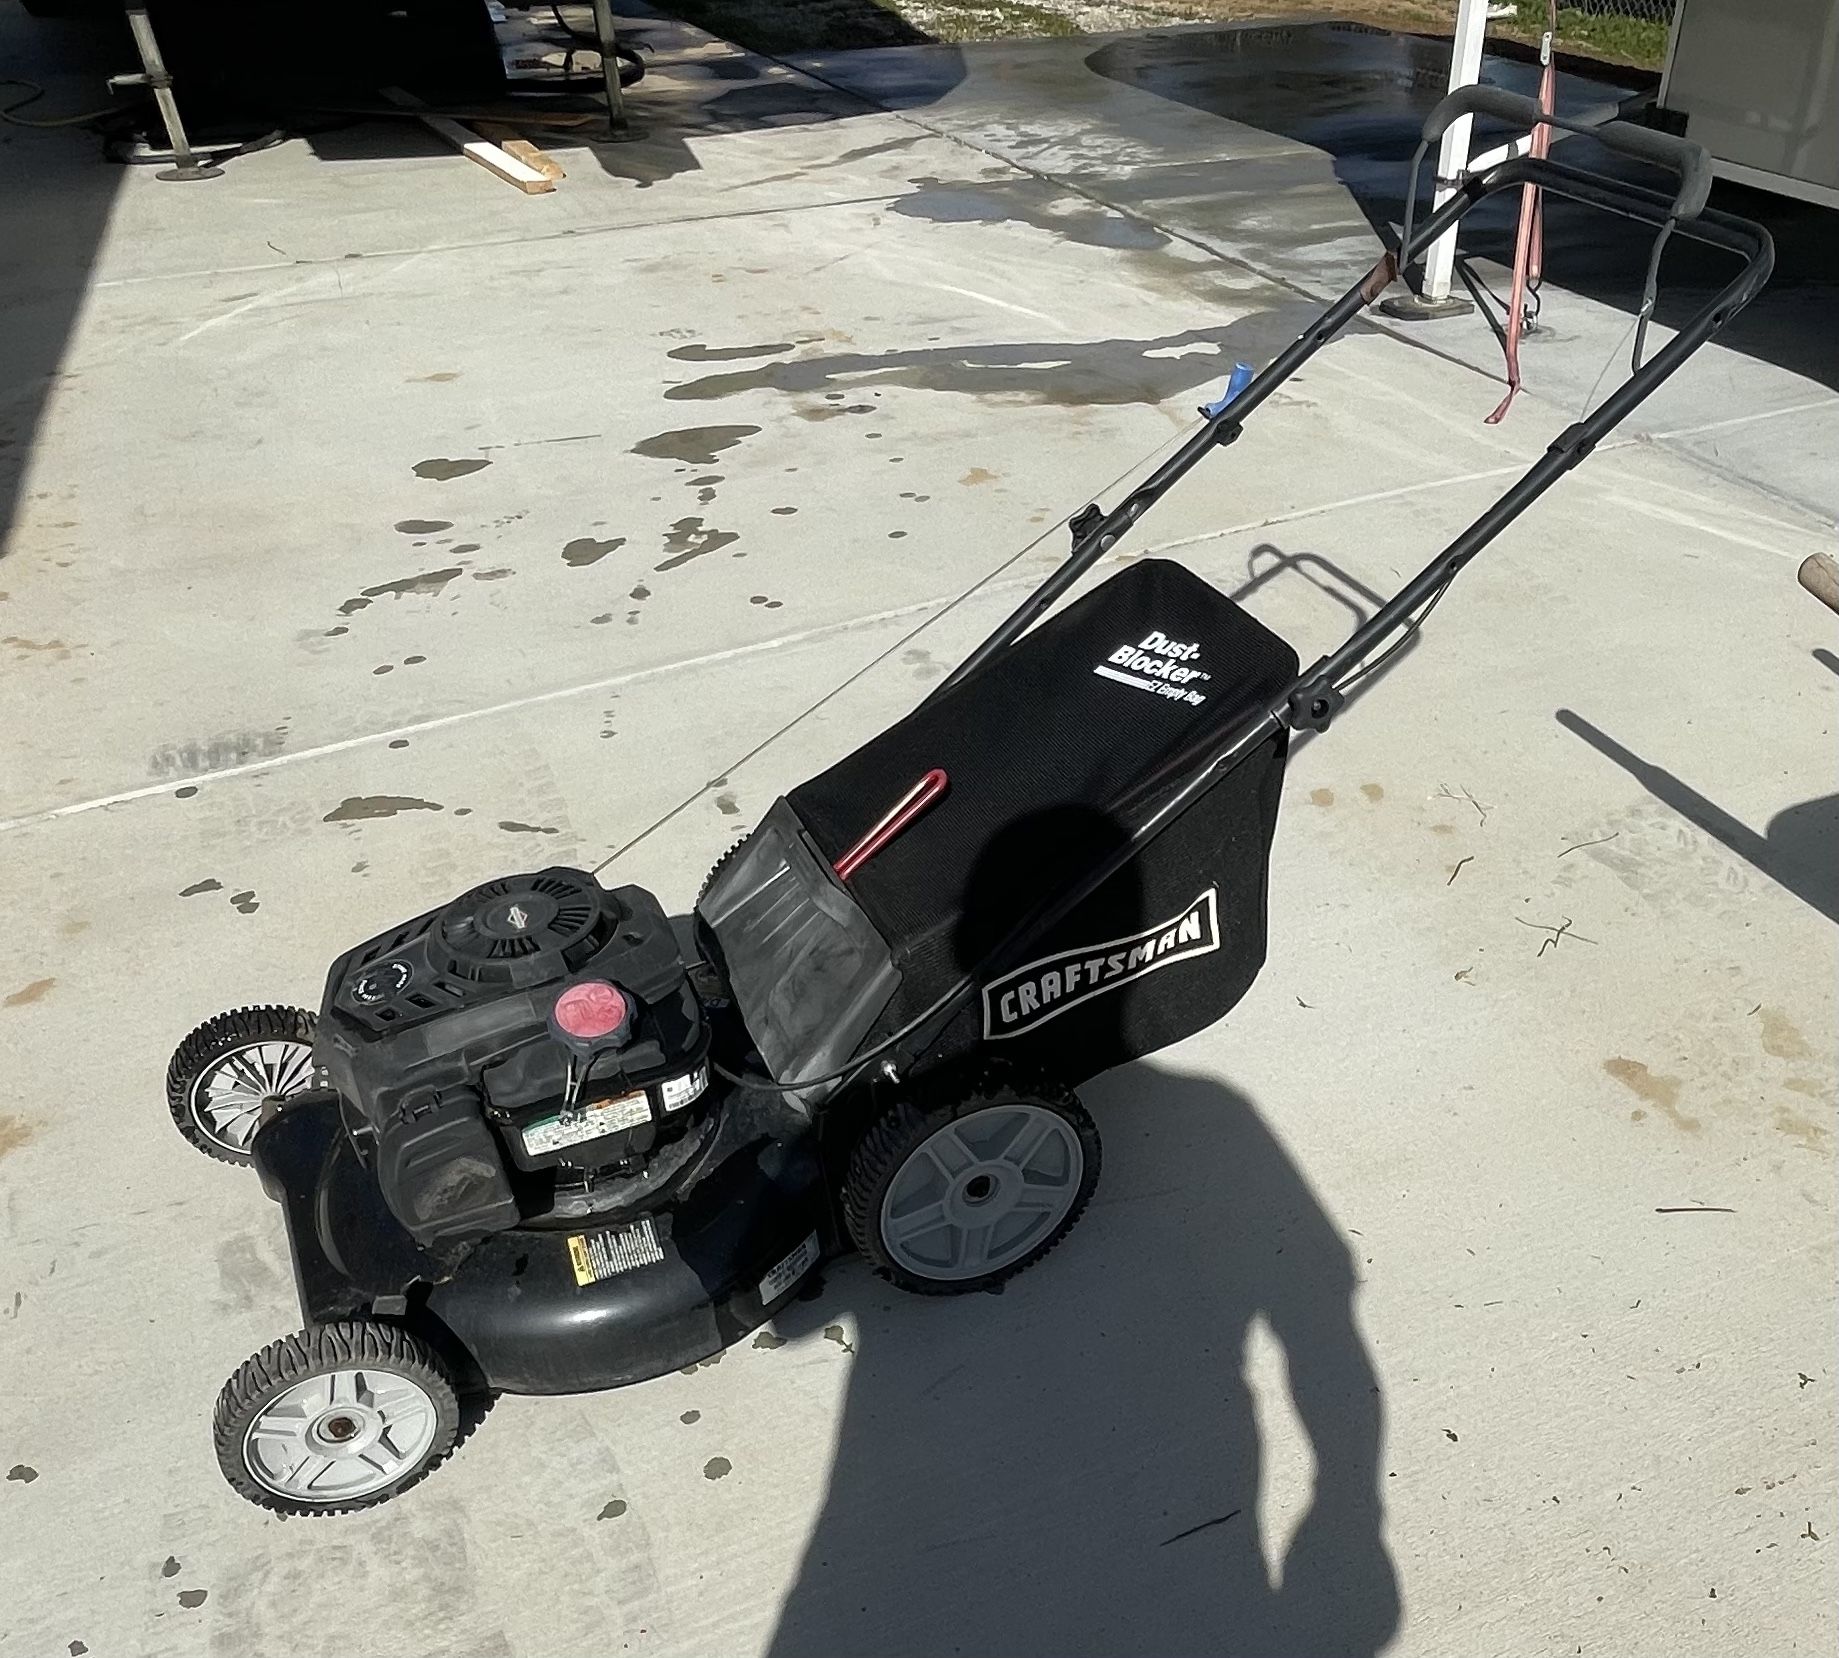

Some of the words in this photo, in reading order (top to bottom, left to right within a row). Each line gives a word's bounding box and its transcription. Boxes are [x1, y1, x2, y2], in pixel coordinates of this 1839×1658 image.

[1156, 683, 1188, 701] Empty
[1183, 690, 1206, 706] Bag
[1000, 911, 1201, 1023] CRAFTSMAN
